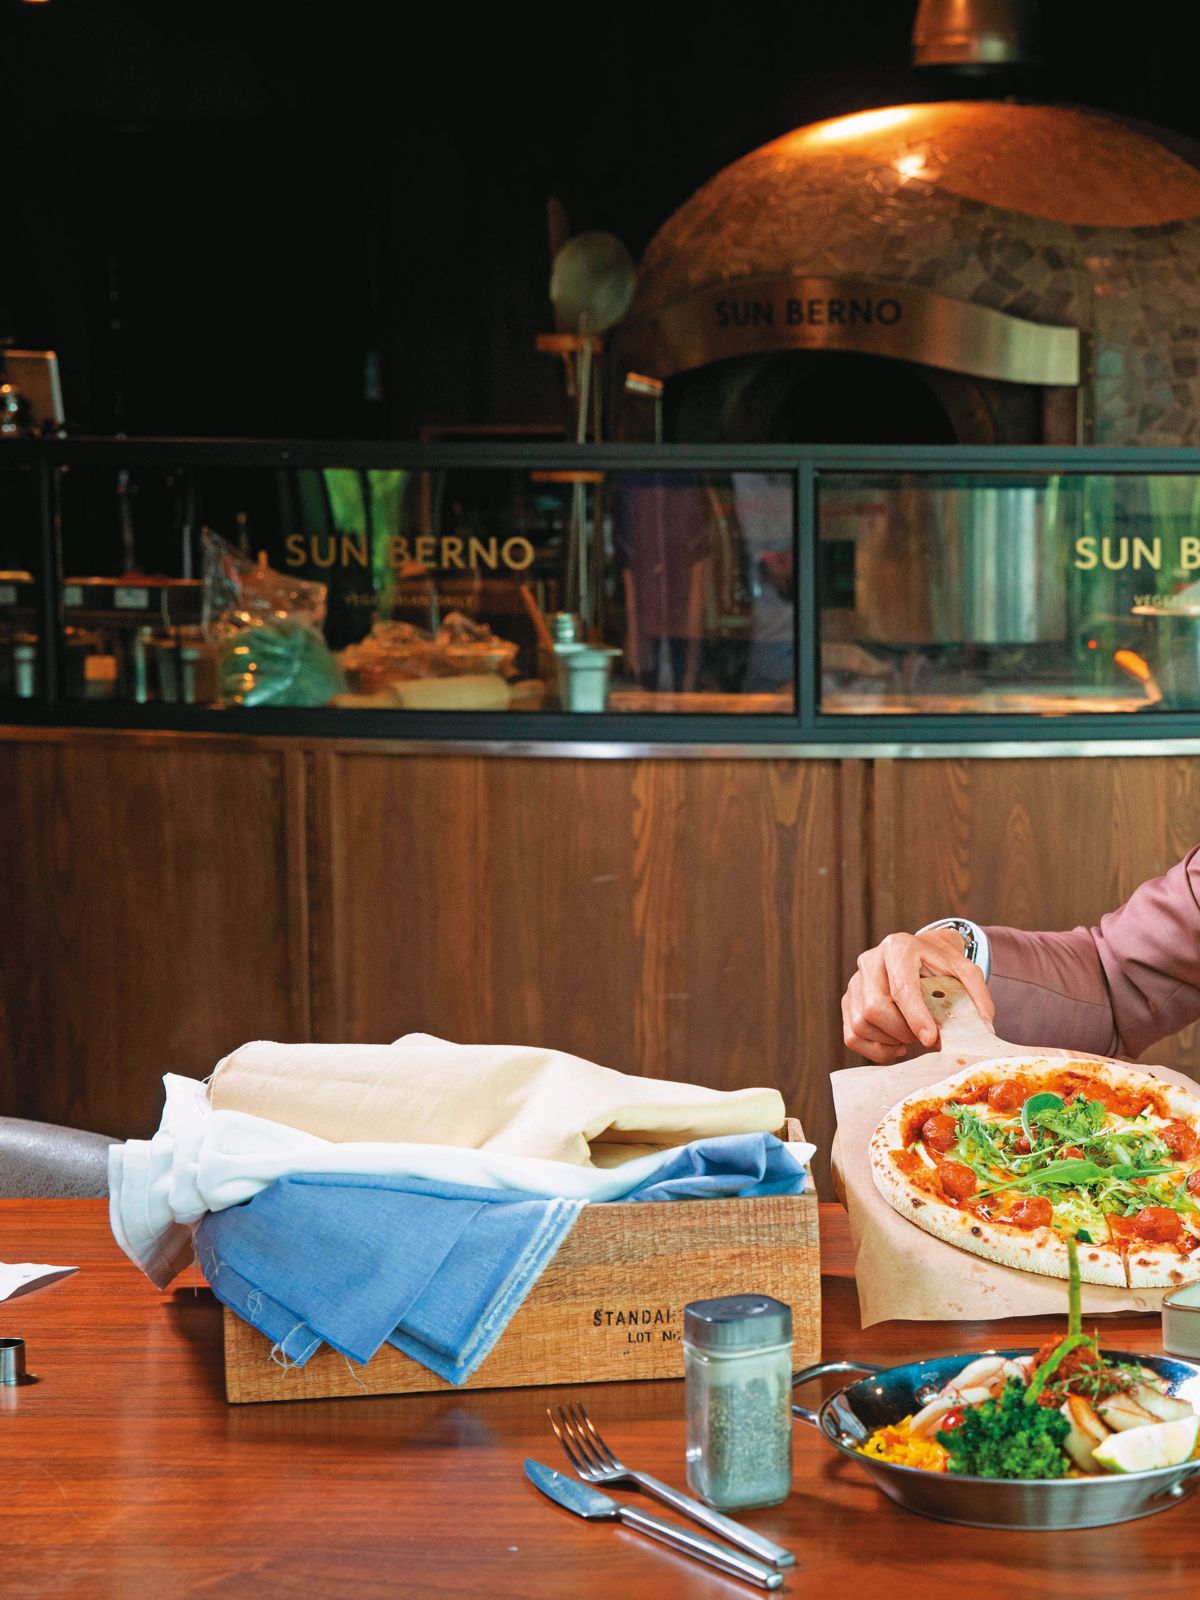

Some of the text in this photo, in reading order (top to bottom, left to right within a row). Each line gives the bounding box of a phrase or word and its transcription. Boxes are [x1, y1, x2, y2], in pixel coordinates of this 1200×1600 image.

[714, 297, 902, 328] SUN BERNO
[284, 534, 536, 571] SUN BERNO
[1074, 536, 1162, 571] SUN
[627, 1331, 652, 1343] LOT
